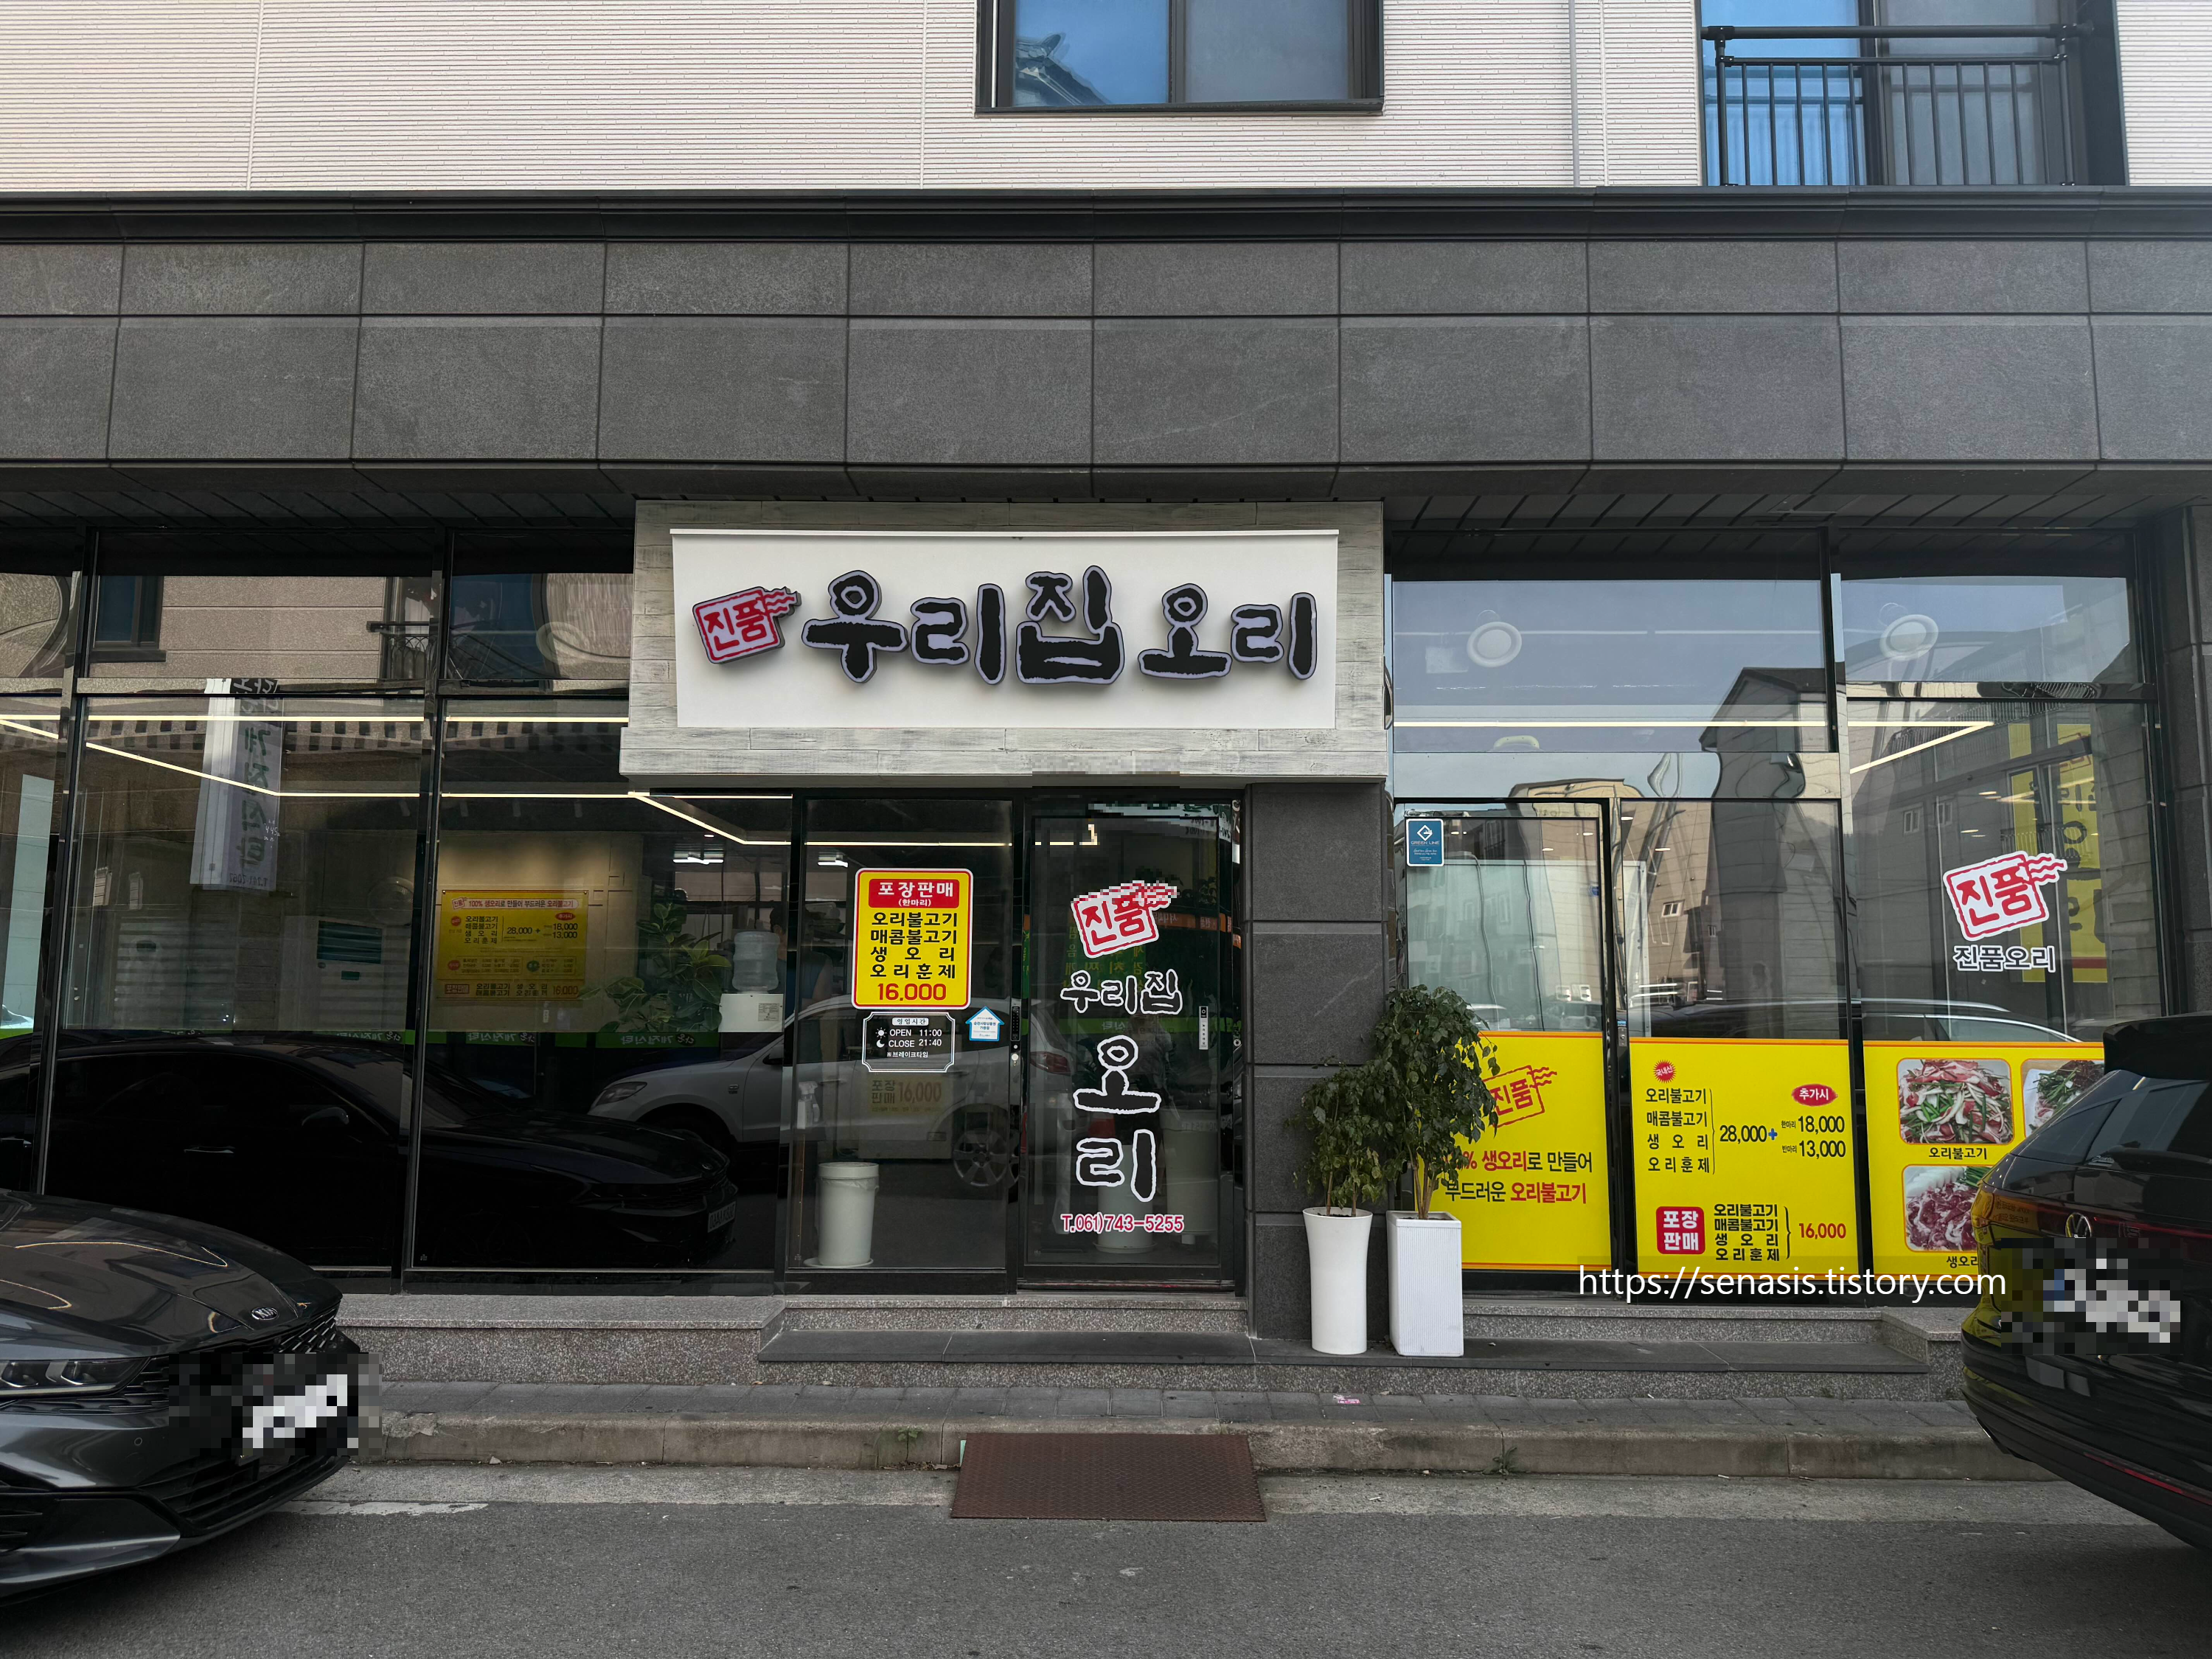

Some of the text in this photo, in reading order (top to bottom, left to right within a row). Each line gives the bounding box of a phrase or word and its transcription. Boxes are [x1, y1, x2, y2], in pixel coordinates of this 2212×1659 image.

[801, 566, 1125, 685] 우리집
[1138, 583, 1316, 680] 오리
[878, 882, 953, 897] 포장판매
[1957, 864, 2032, 927] 진품
[898, 899, 931, 907] (한마리)
[553, 923, 578, 931] 18,000
[872, 912, 958, 928] 오리불고기
[507, 927, 532, 935] 28,000
[871, 929, 957, 945] 매콤불고기
[1952, 945, 2056, 973] 진품오리
[870, 963, 956, 979] 오리훈제
[877, 983, 947, 1001] 16,000
[1060, 969, 1182, 1015] 우리집
[889, 1029, 942, 1037] OPEN 11:00
[888, 1038, 942, 1048] CLOSE 21:40
[1656, 1065, 1674, 1077] 국내산
[897, 1082, 942, 1104] 16,000
[1489, 1078, 1534, 1116] 진품
[1645, 1088, 1707, 1105] 오리불고기
[1799, 1088, 1829, 1100] 추가시
[1646, 1110, 1708, 1127] 매콤불고기
[1781, 1116, 1845, 1134] 한마리 18,000
[1719, 1125, 1767, 1144] 28,000
[1782, 1140, 1846, 1159] 반마리 13,000
[1929, 1147, 1987, 1161] 오리불고기
[1481, 1150, 1543, 1172] 생오리로
[1547, 1151, 1593, 1173] 만들어
[1648, 1156, 1710, 1173] 오리훈제
[1445, 1181, 1587, 1204] 부드러운 오리불고기
[1714, 1203, 1778, 1217] 오리불고기
[1061, 1213, 1184, 1234] T.061)743-5255
[1663, 1210, 1698, 1229] 포장
[1714, 1218, 1778, 1232] 매콤불고기
[1798, 1222, 1846, 1240] 16,000
[1663, 1232, 1699, 1251] 판매
[1716, 1248, 1780, 1262] 오리훈제
